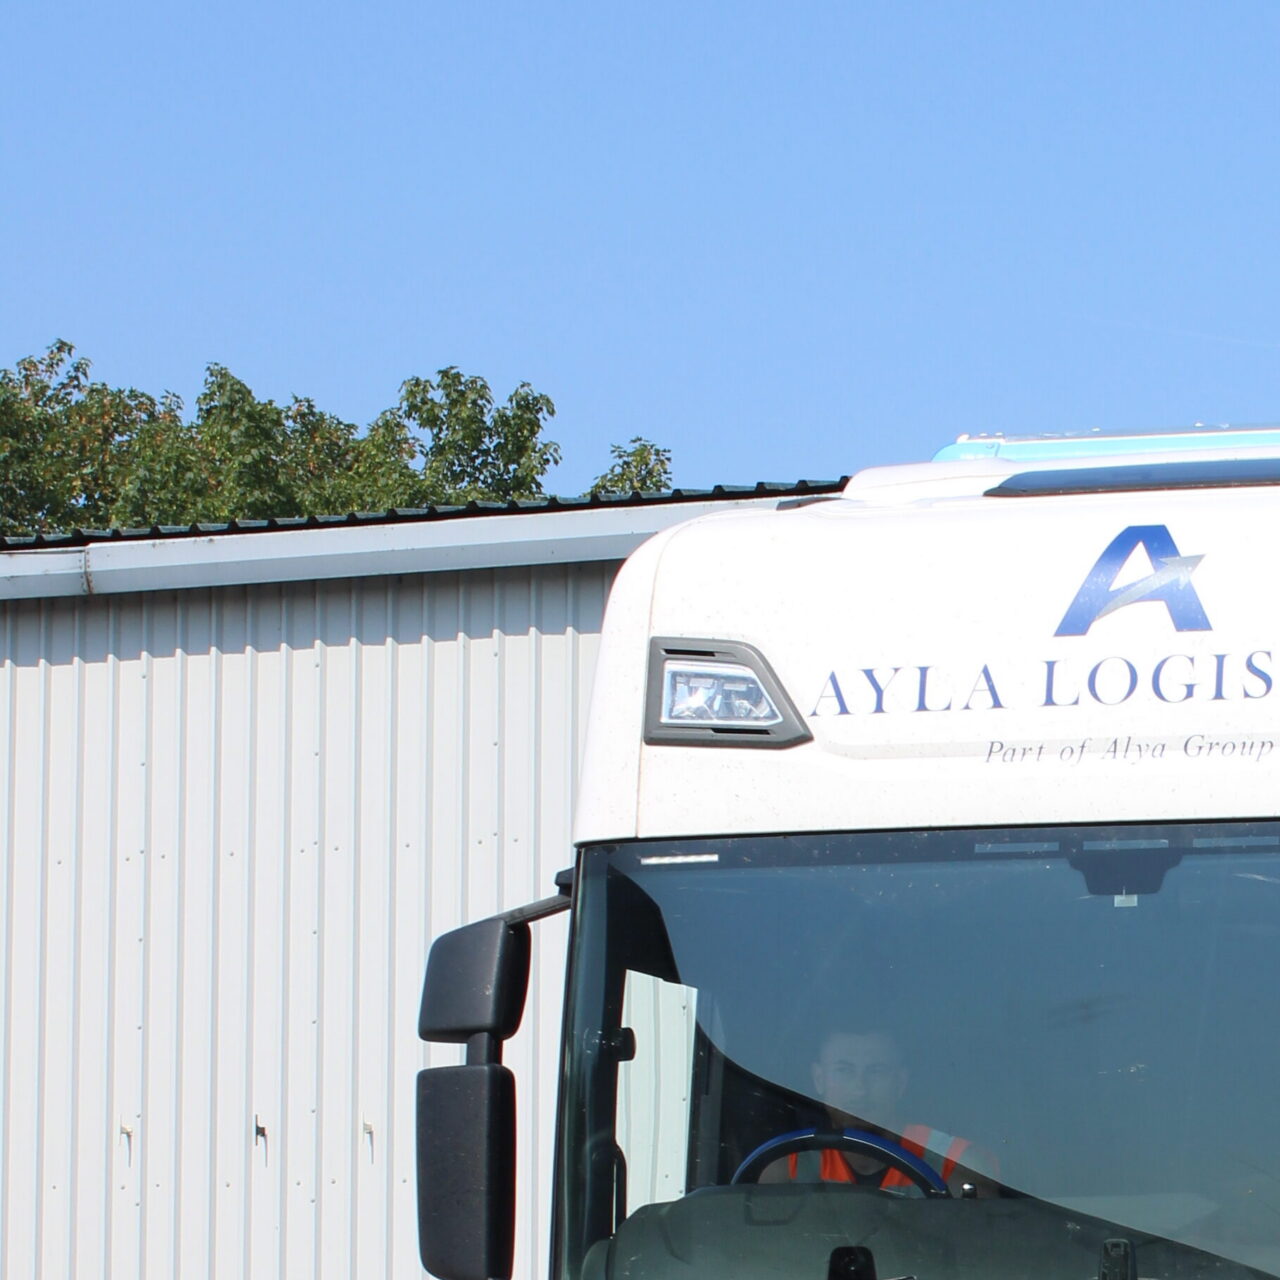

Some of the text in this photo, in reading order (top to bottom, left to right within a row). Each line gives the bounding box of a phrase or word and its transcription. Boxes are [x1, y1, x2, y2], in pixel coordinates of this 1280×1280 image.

[807, 663, 1004, 717] AYLA
[985, 734, 1275, 765] Part of Alya Group
